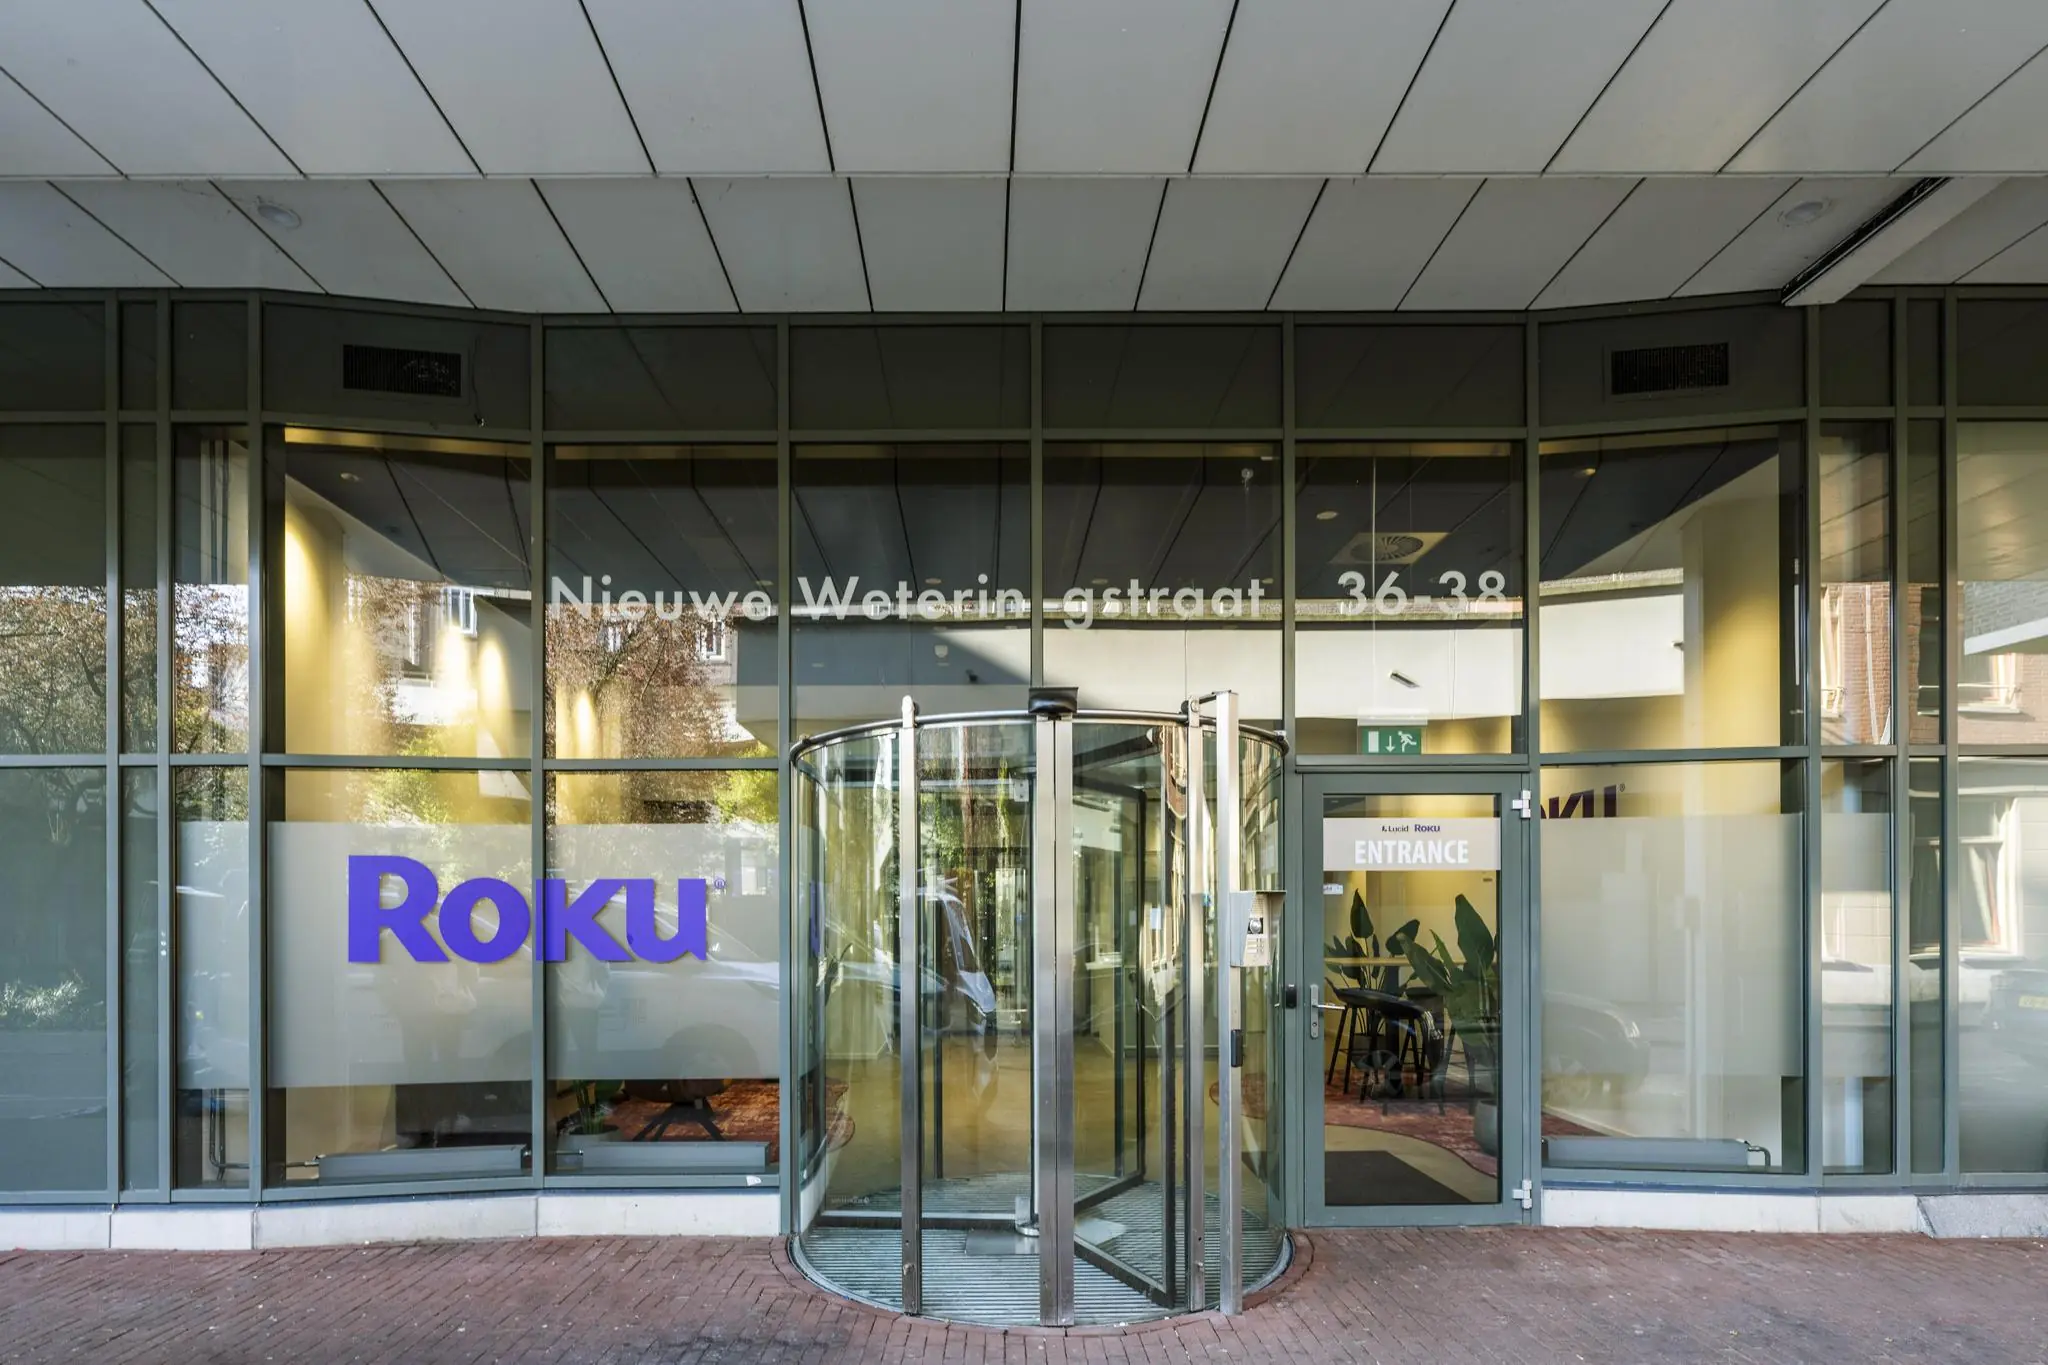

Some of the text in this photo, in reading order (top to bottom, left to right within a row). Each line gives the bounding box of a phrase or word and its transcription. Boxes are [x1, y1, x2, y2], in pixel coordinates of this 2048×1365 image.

[551, 570, 1507, 630] Nieuwe Weterin gstraat 36-38
[1355, 839, 1469, 865] ENTRANCE
